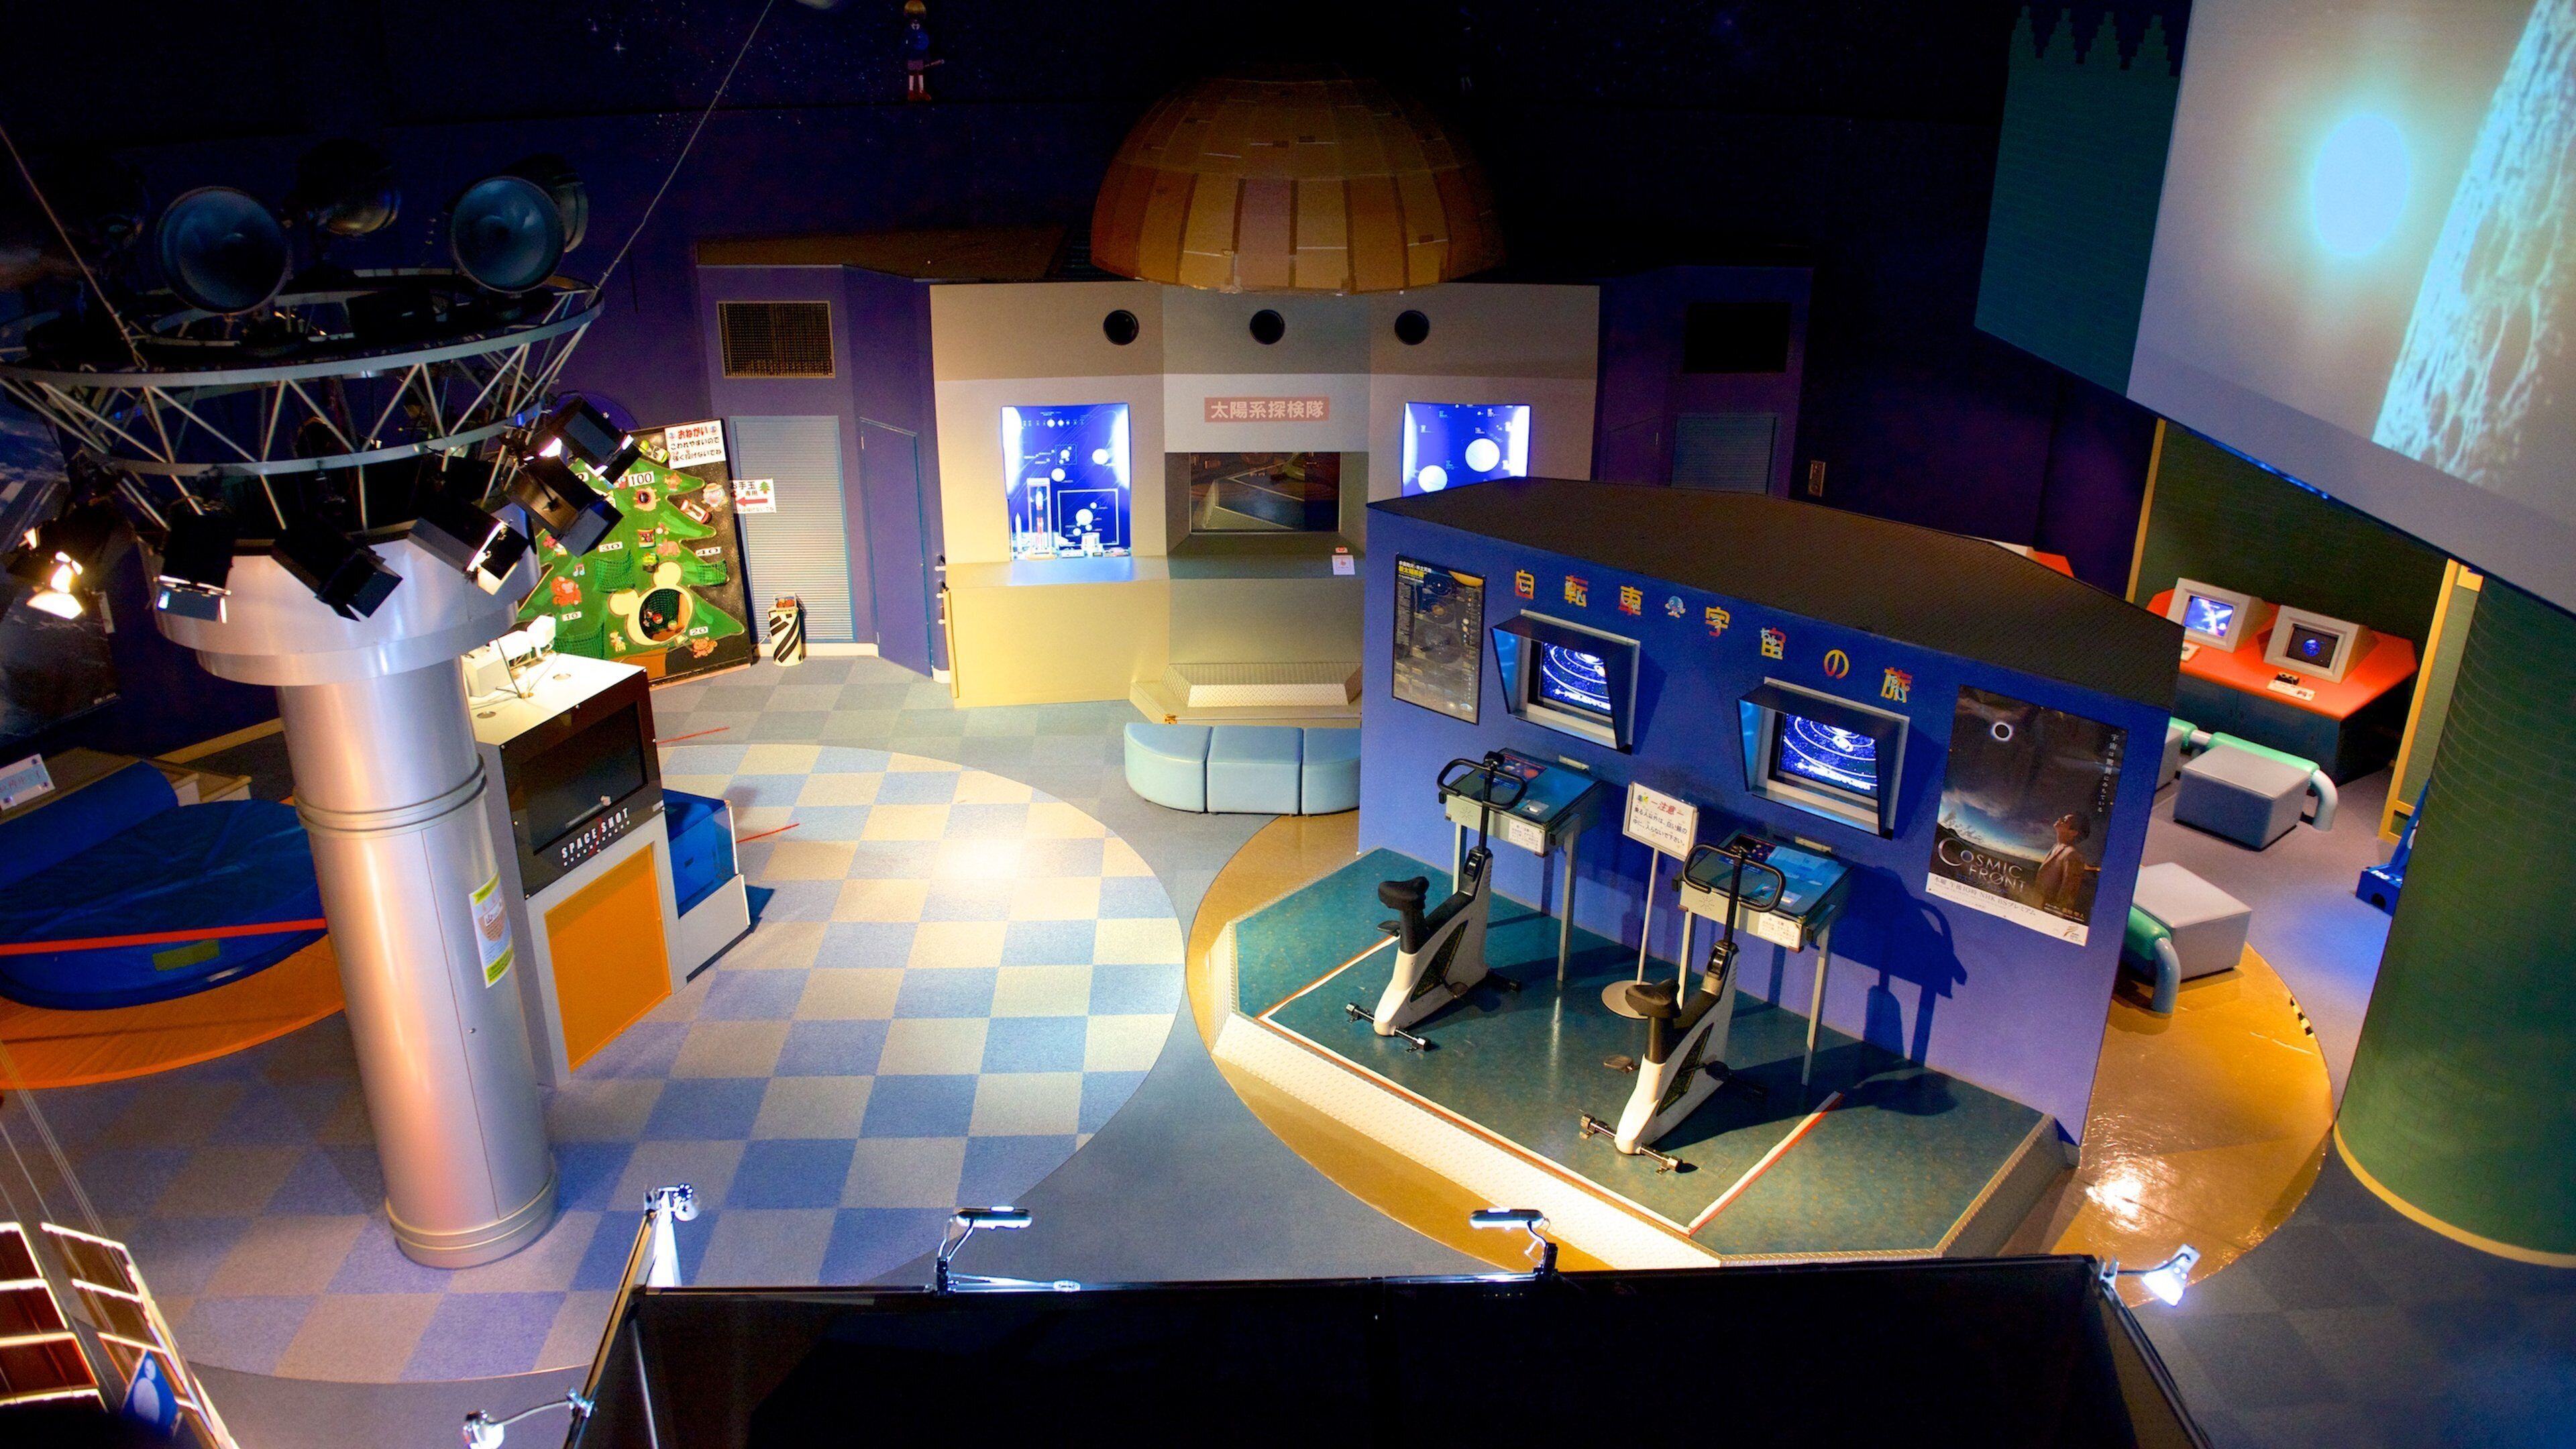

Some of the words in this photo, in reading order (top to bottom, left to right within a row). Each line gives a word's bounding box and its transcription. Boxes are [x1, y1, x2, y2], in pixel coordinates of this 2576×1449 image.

[1211, 400, 1324, 419] 太陽系探検隊
[678, 425, 709, 439] おねがい
[670, 437, 720, 450] こわれやすいので
[630, 473, 653, 486] 100
[601, 542, 621, 551] 30
[697, 547, 720, 556] 40
[561, 828, 597, 859] SPACE
[601, 807, 628, 833] SHOT
[1938, 837, 2023, 879] COSMIC
